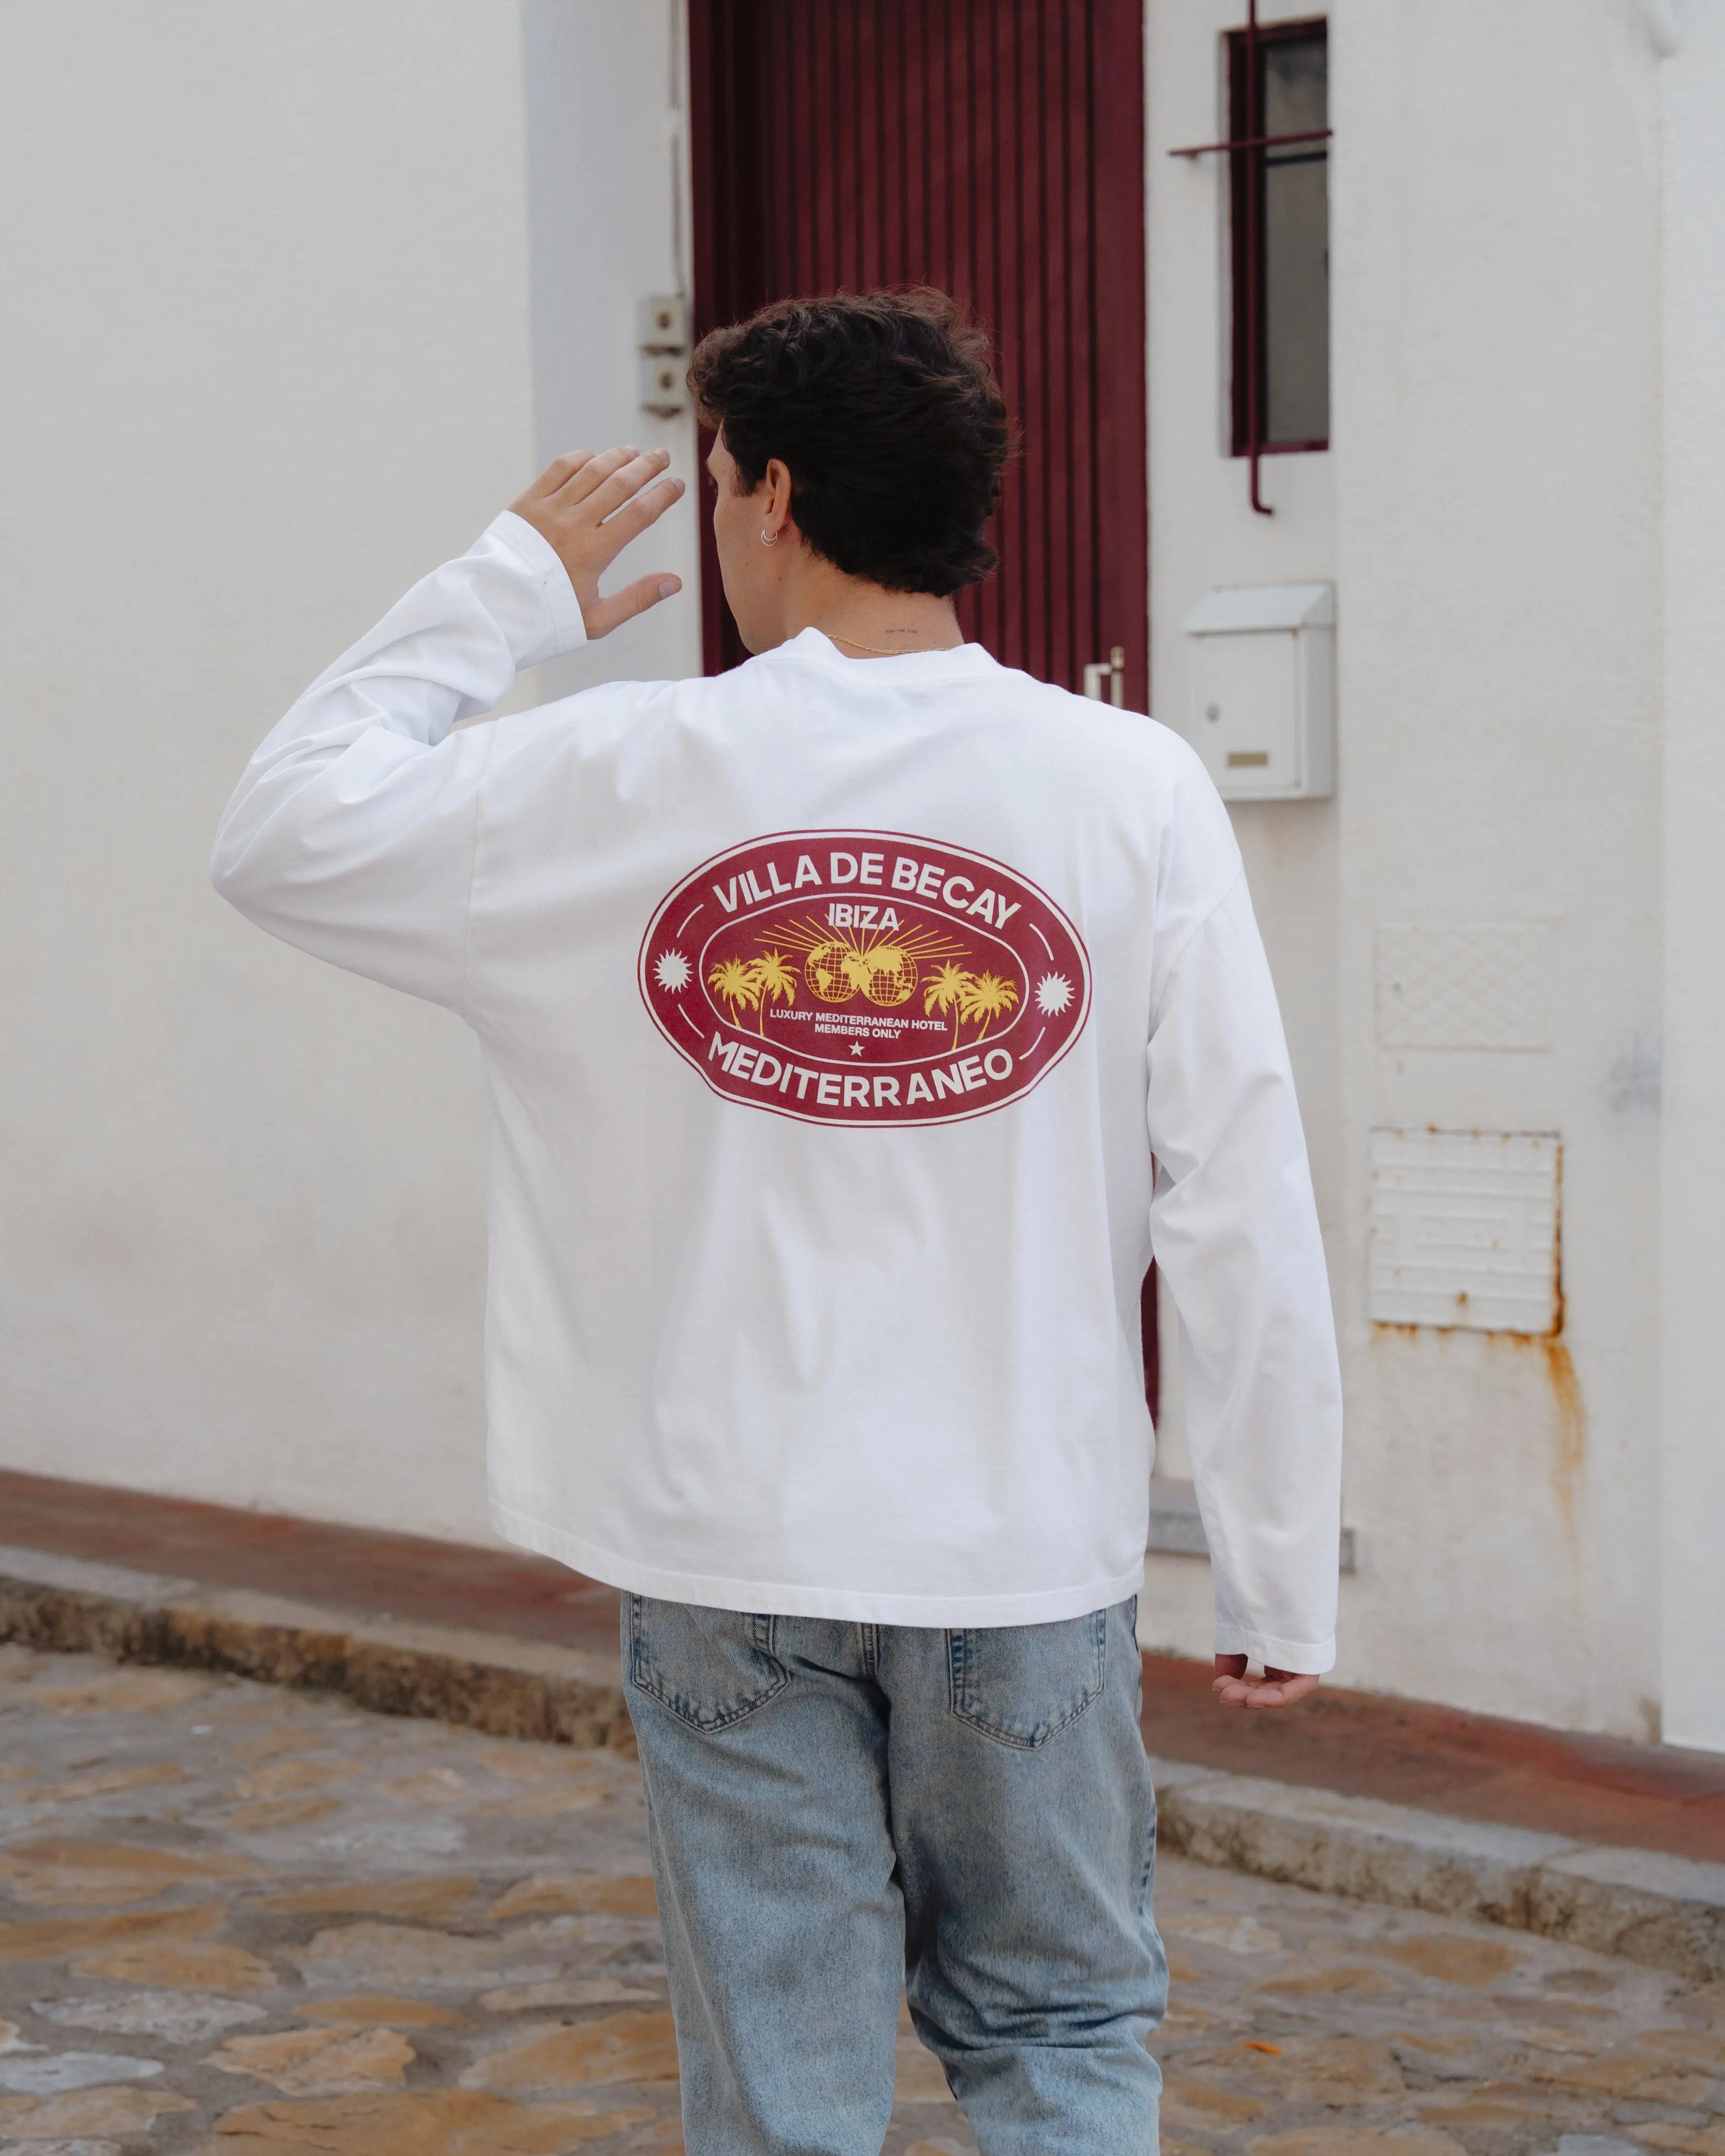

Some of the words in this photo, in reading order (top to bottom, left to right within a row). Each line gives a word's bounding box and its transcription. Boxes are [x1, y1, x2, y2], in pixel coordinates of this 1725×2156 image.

[712, 855, 823, 913] VILLA
[830, 852, 884, 886] DE
[891, 856, 1022, 930] BECAY
[828, 903, 899, 931] IBIZA
[770, 1009, 813, 1021] LUXURY
[815, 1012, 908, 1029] MEDITERRANEAN
[911, 1019, 948, 1031] HOTEL
[814, 1023, 869, 1037] MEMBERS
[872, 1028, 901, 1039] ONLY
[708, 1031, 1013, 1108] MEDITERRANEO
